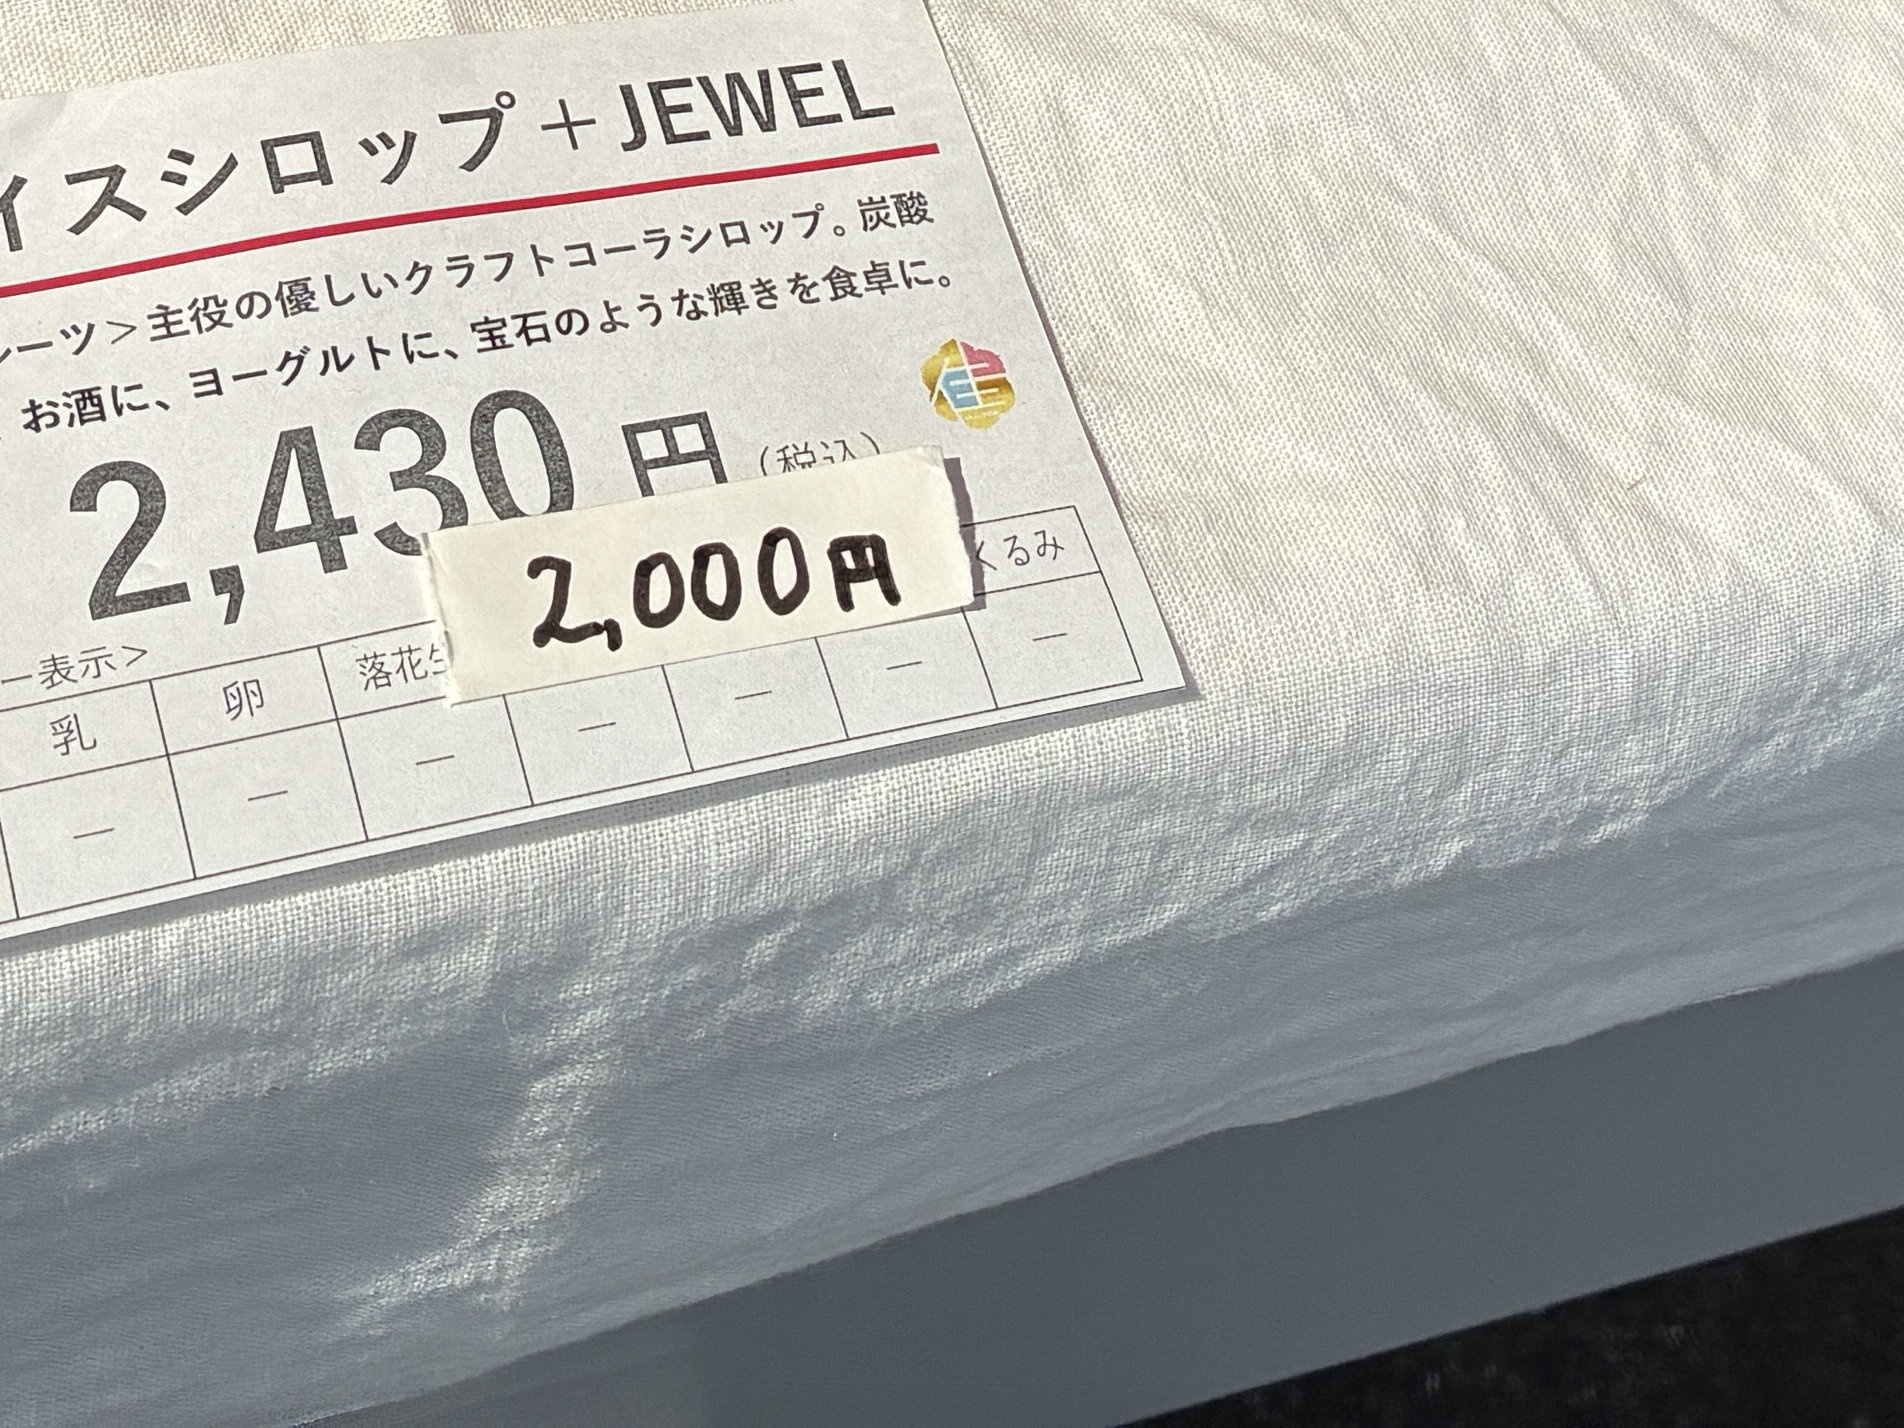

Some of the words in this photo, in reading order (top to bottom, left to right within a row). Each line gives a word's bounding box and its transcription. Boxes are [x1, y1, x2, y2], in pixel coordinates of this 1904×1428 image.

[618, 57, 895, 155] JEWEL
[68, 388, 577, 626] 2,430
[526, 526, 902, 652] 2,000円
[49, 715, 97, 758] 乳
[221, 679, 266, 721] 卵
[972, 528, 1066, 573] くるみ
